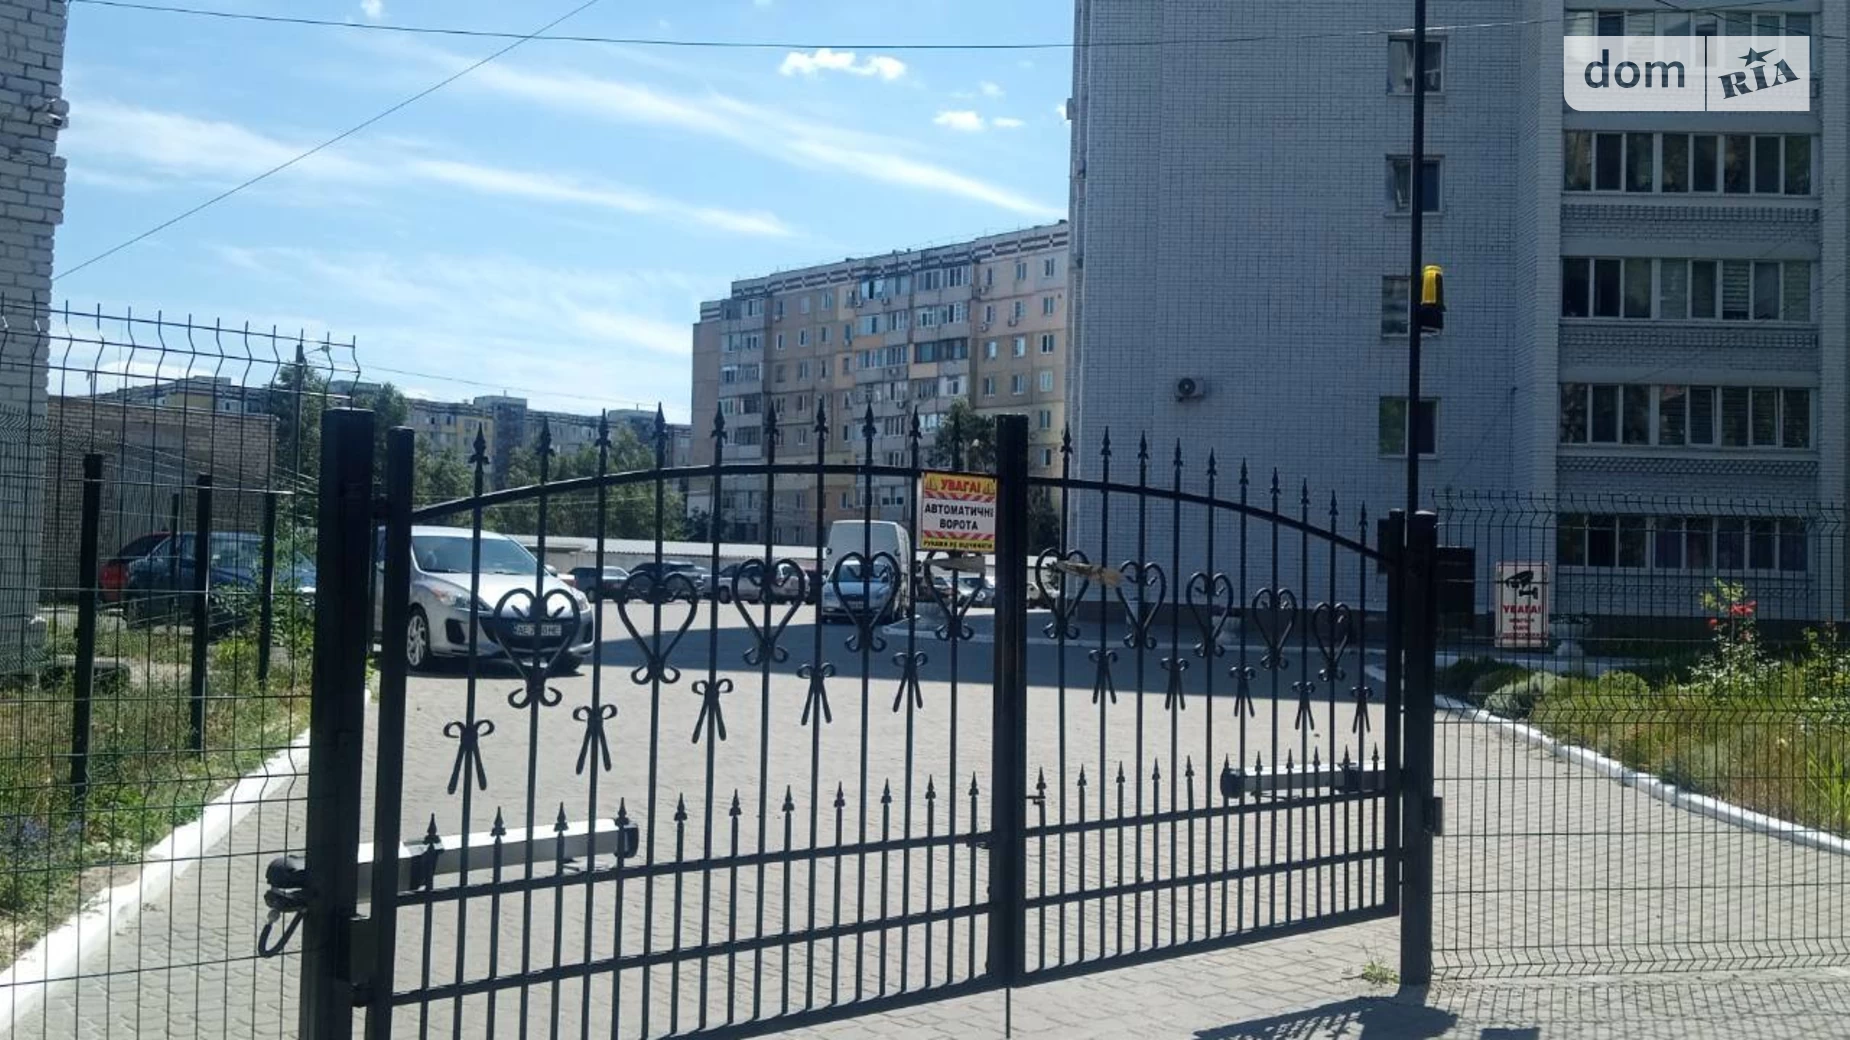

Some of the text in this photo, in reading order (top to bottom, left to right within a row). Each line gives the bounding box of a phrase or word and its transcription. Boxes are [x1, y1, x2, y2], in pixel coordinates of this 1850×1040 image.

[940, 478, 981, 493] УВАГА!
[924, 503, 994, 518] АВТОМАТИЧНІ
[939, 519, 978, 530] ВОРОТА
